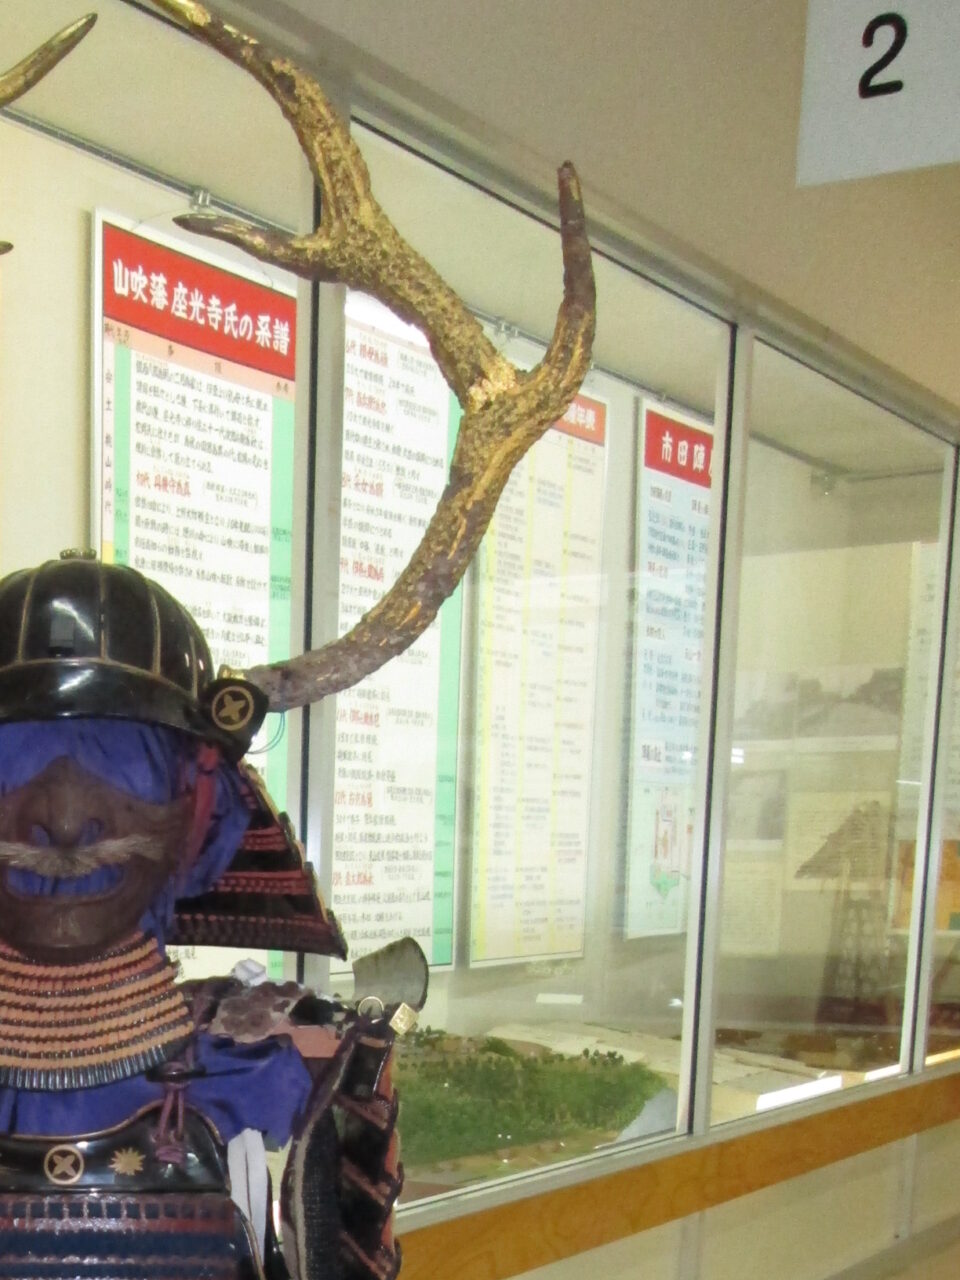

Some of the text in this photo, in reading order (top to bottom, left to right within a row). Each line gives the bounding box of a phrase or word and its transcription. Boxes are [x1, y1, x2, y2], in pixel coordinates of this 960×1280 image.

[858, 12, 908, 99] 2
[661, 430, 713, 477] 市田陣
